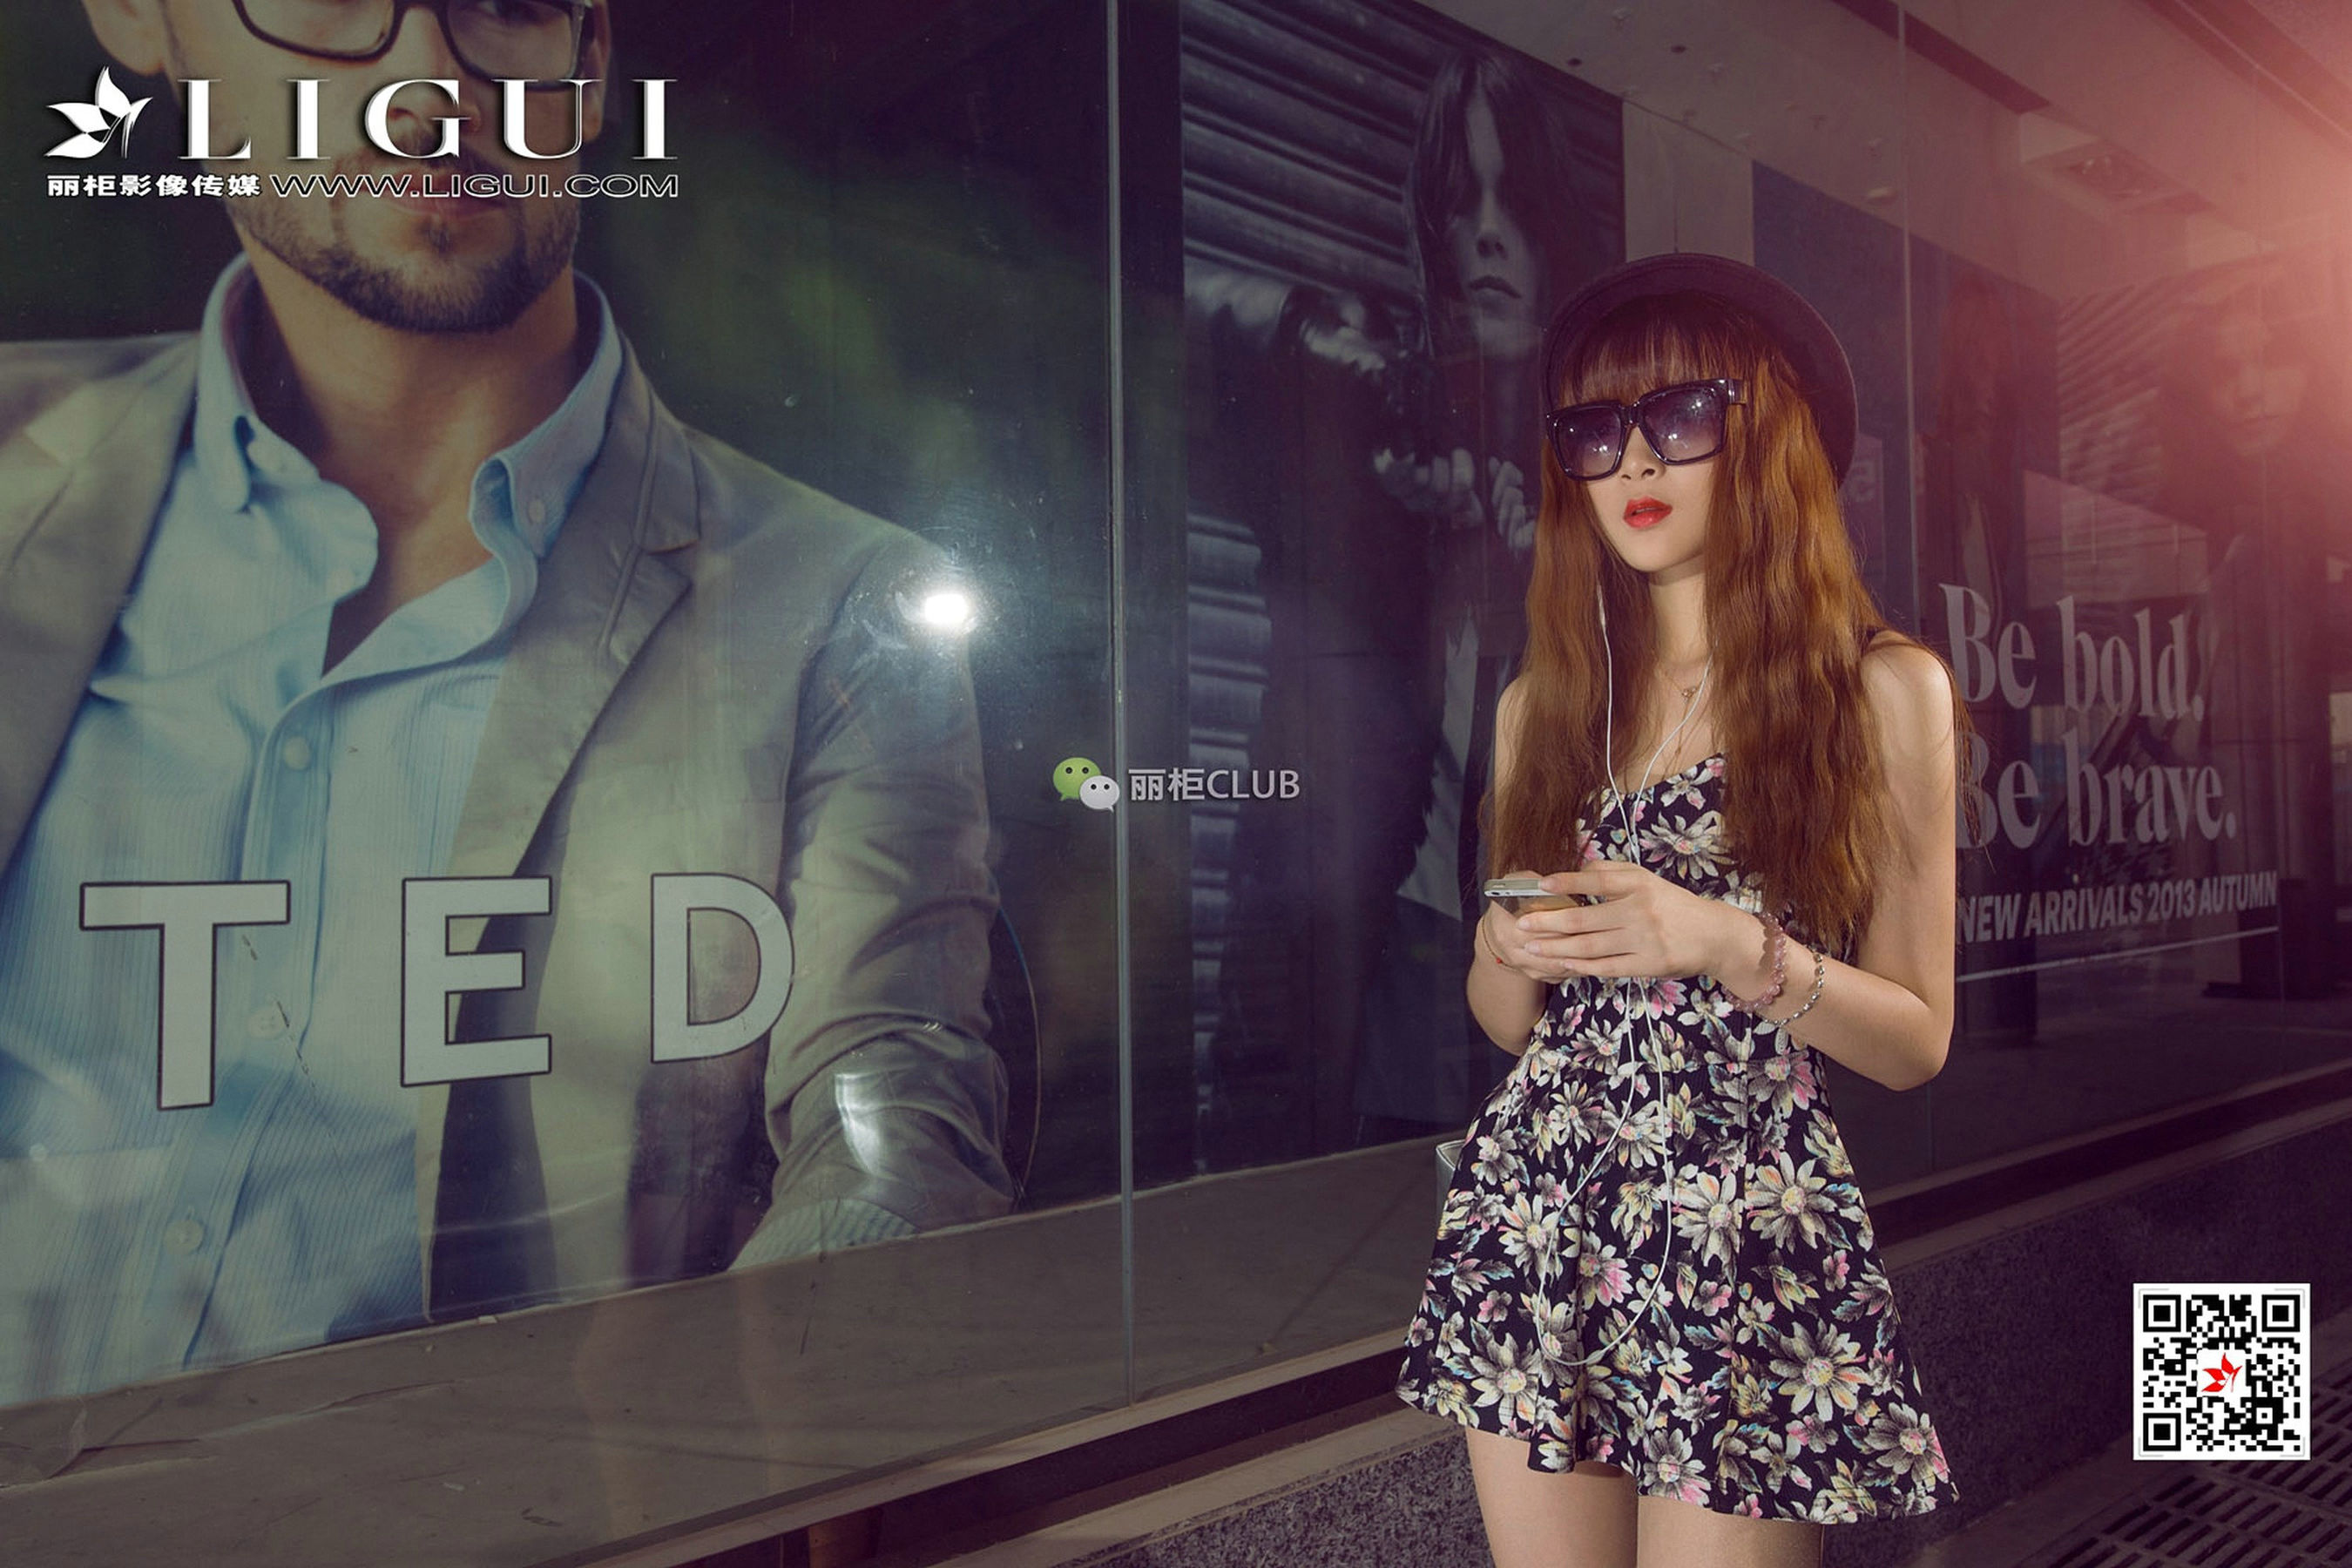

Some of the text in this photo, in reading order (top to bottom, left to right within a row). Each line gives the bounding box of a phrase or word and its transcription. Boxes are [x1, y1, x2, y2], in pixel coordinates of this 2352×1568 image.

[1939, 583, 2038, 710] Be
[2062, 727, 2238, 848] brave.
[2024, 882, 2144, 937] ARRIVALS
[2146, 877, 2197, 922] 2013
[2197, 872, 2278, 916] AUTUMN
